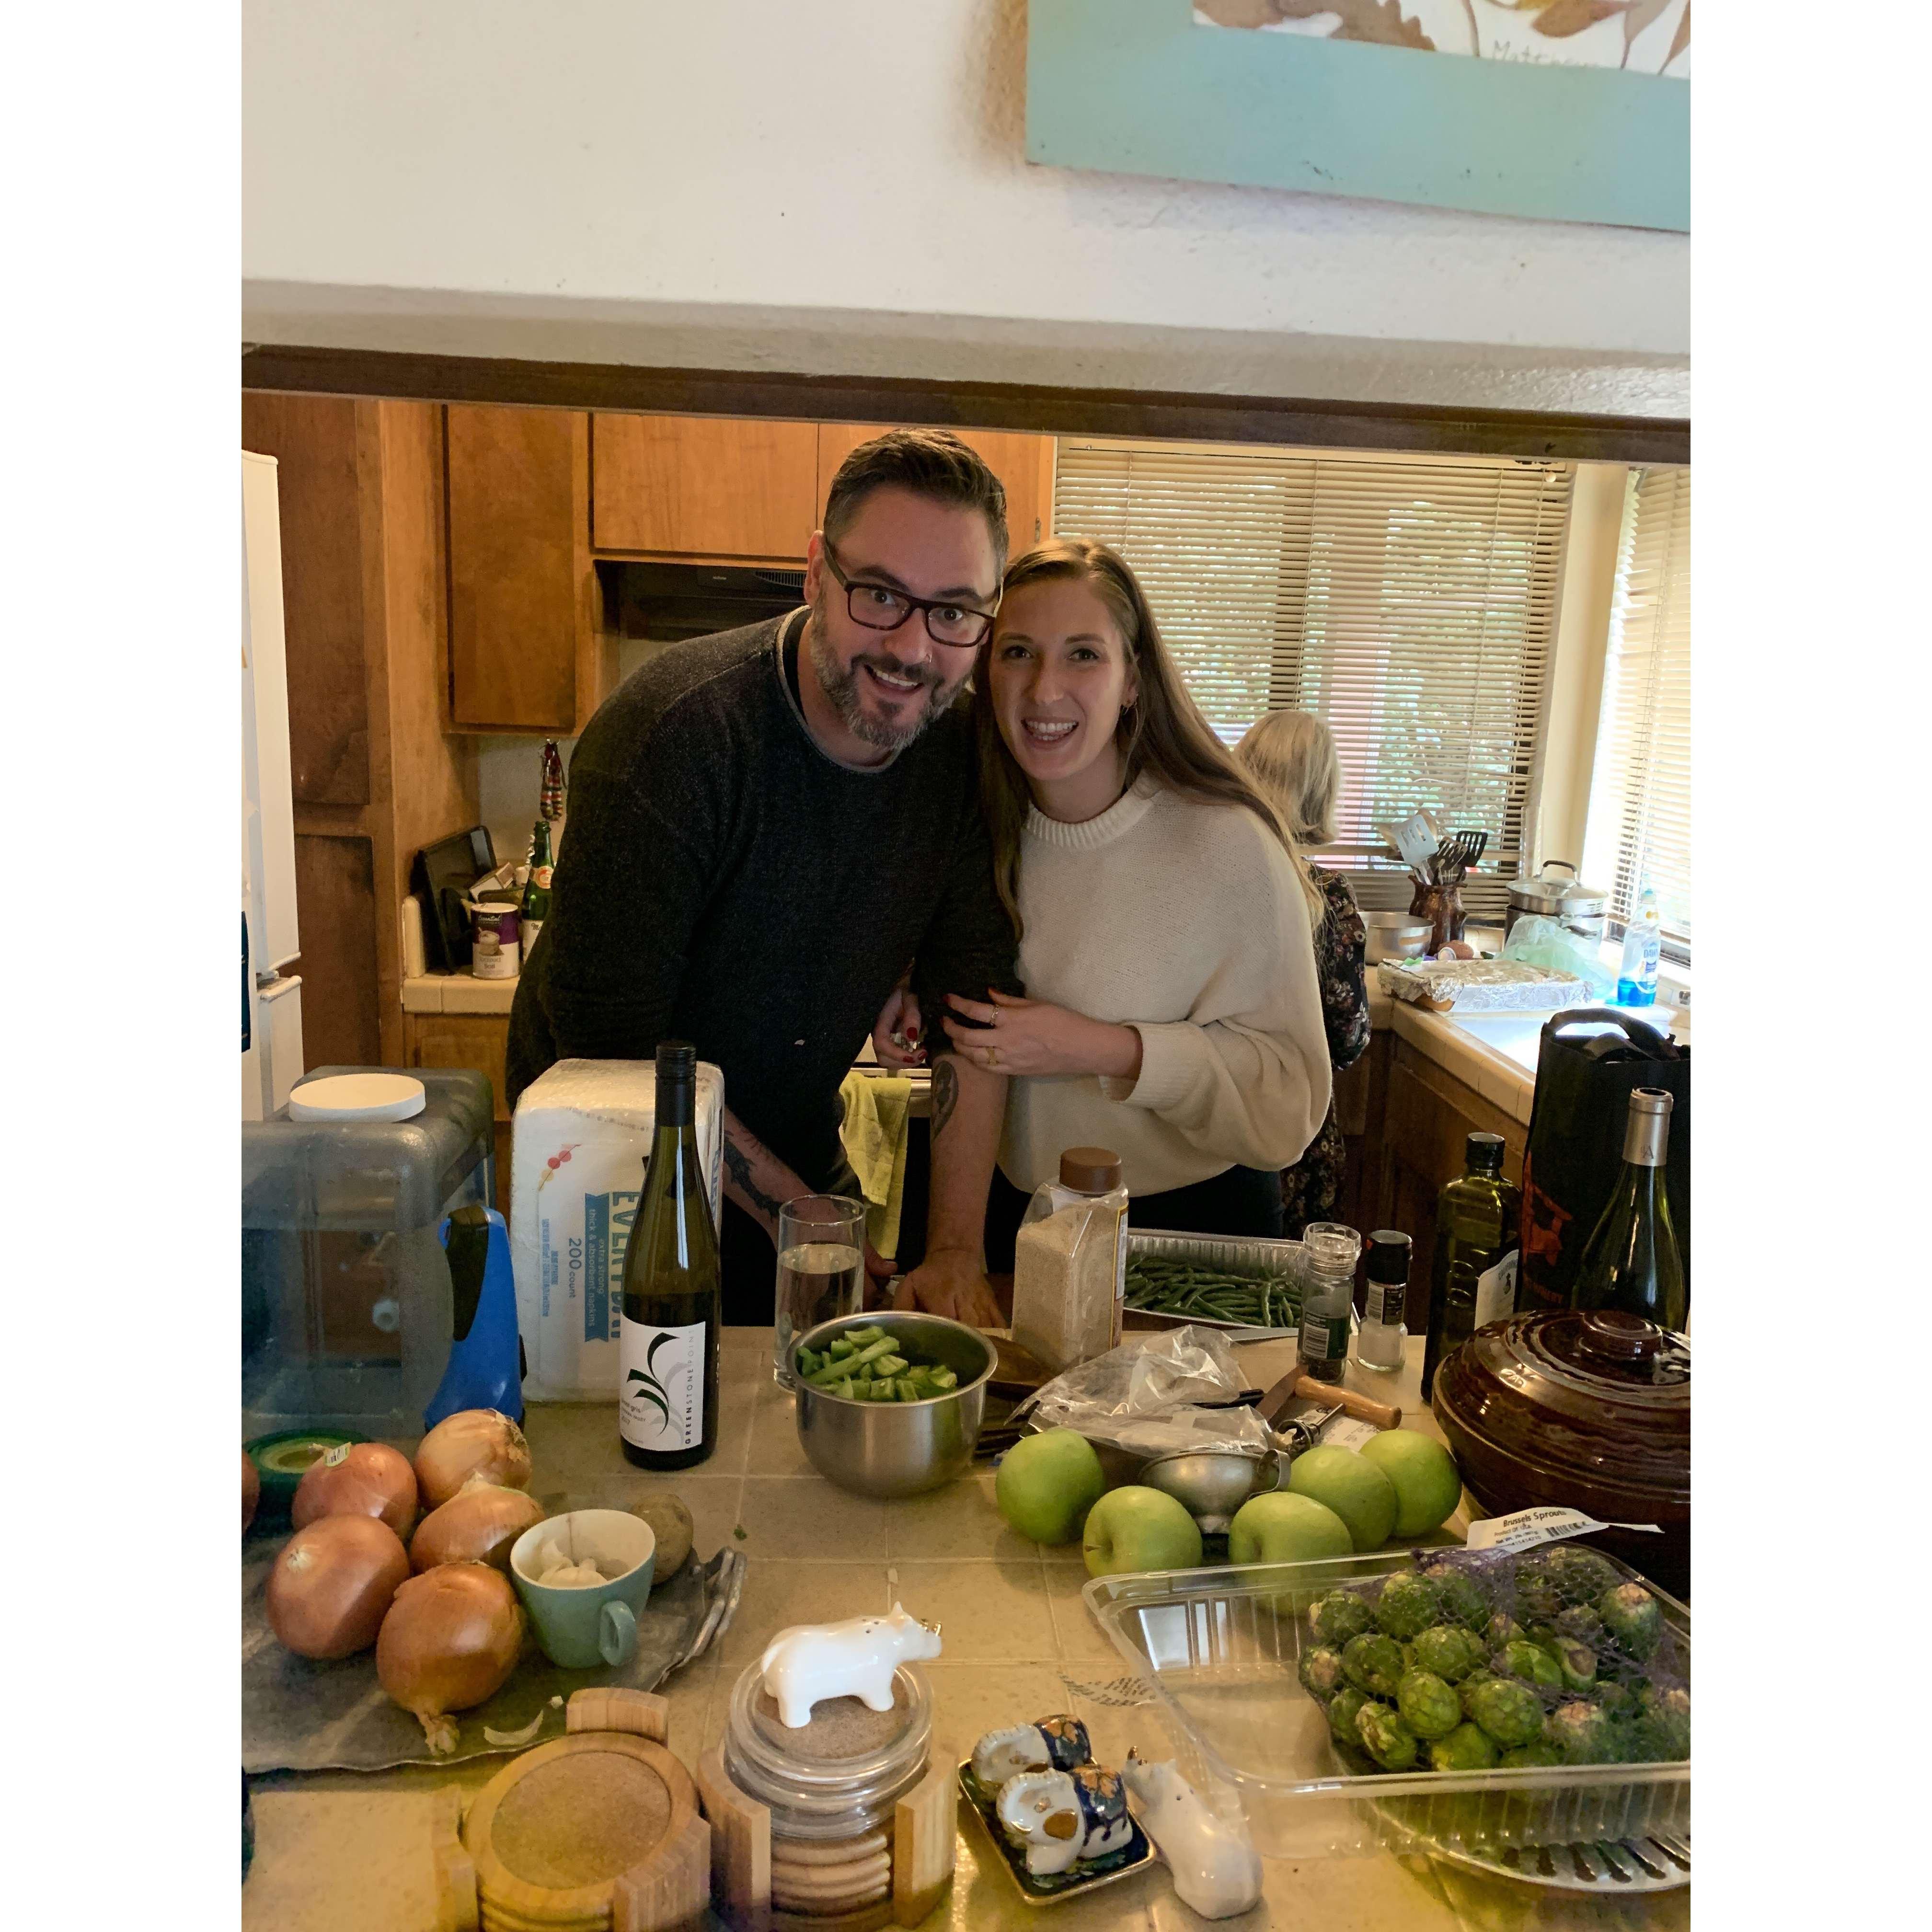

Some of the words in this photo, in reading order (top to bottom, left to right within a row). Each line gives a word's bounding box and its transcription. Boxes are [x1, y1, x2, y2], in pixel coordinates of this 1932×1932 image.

[568, 1238, 582, 1270] 200
[568, 1271, 576, 1299] count
[587, 1292, 596, 1327] napkins
[1503, 1514, 1531, 1527] Brussels
[1533, 1510, 1566, 1521] Sprouts
